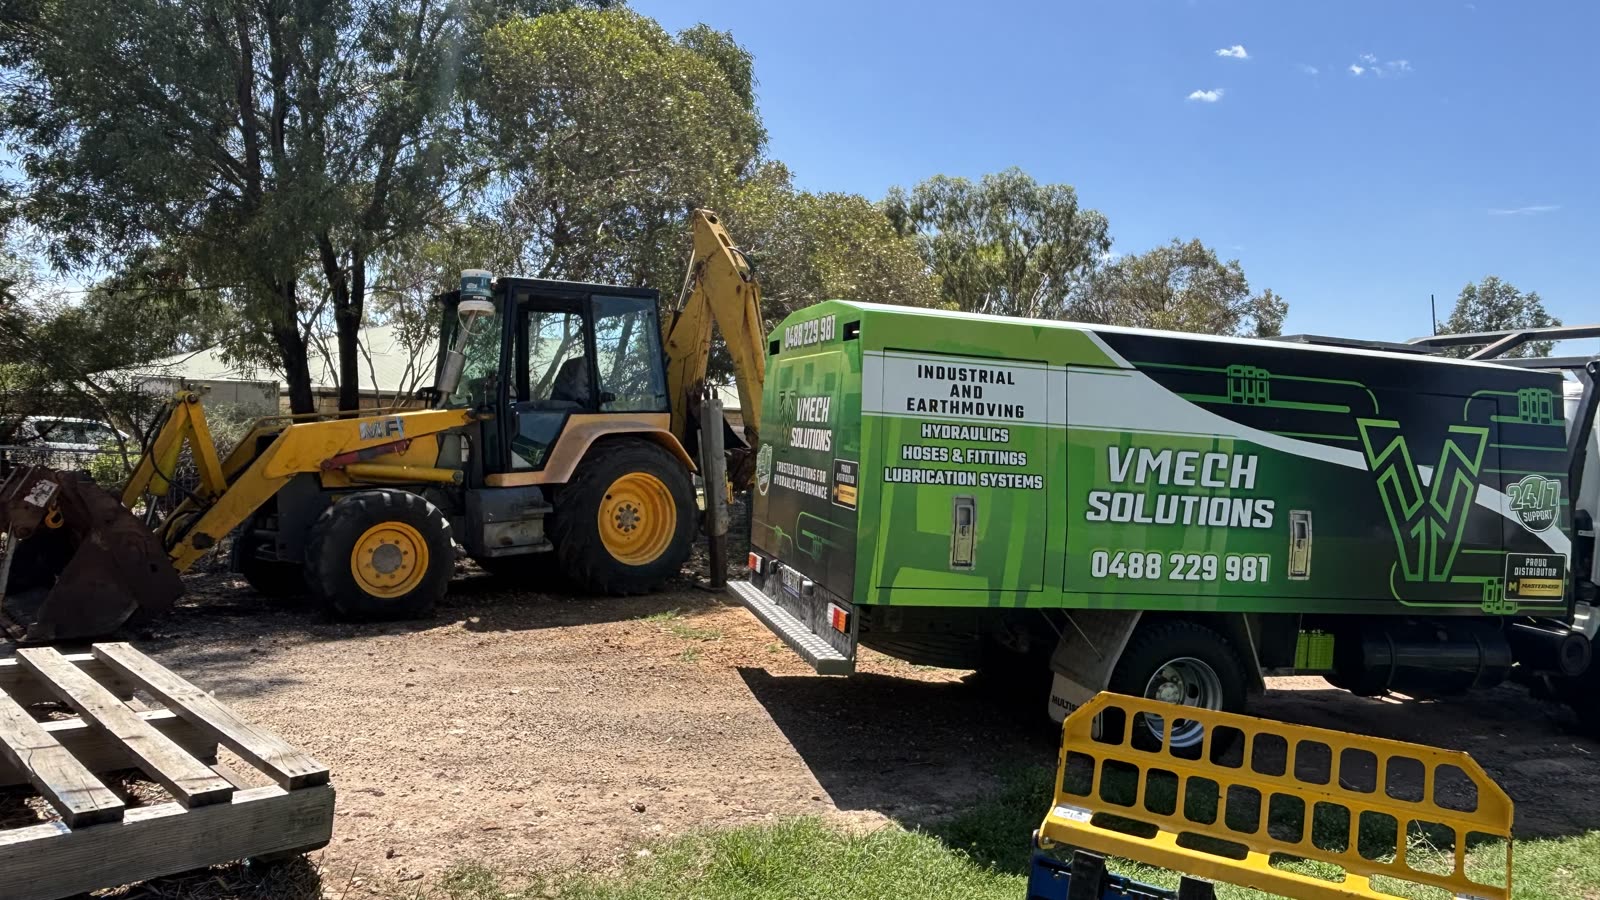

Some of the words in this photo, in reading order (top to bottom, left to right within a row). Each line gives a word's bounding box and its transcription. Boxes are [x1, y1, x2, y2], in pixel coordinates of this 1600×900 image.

[785, 324, 802, 348] 0488
[804, 320, 818, 344] 229
[821, 315, 836, 341] 981
[917, 364, 1015, 385] INDUSTRIAL
[949, 384, 983, 399] AND
[796, 397, 830, 422] VMECH
[906, 398, 1025, 418] EARTHMOVING
[791, 428, 831, 451] SOLUTIONS
[921, 423, 1009, 442] HYDRAULICS
[902, 445, 949, 462] HOSES
[951, 449, 964, 464] &
[966, 450, 1027, 466] FITTINGS
[777, 461, 793, 475] TRUSTED
[794, 465, 816, 480] SOLUTIONS
[817, 470, 826, 483] FOR
[884, 467, 977, 486] LUBRICATION
[980, 472, 1043, 489] SYSTEMS
[1108, 446, 1258, 489] VMECH
[774, 474, 795, 489] HYDRAULIC
[796, 480, 827, 499] PERFORMANCE
[1509, 481, 1559, 509] 24/7
[1086, 491, 1275, 529] SOLUTIONS
[1523, 510, 1552, 521] SUPPORT
[1091, 551, 1162, 579] 0488
[1168, 554, 1218, 580] 229
[1225, 556, 1269, 582] 981
[1514, 567, 1557, 577] DISTRIBUTOR
[1525, 558, 1547, 567] PROUD
